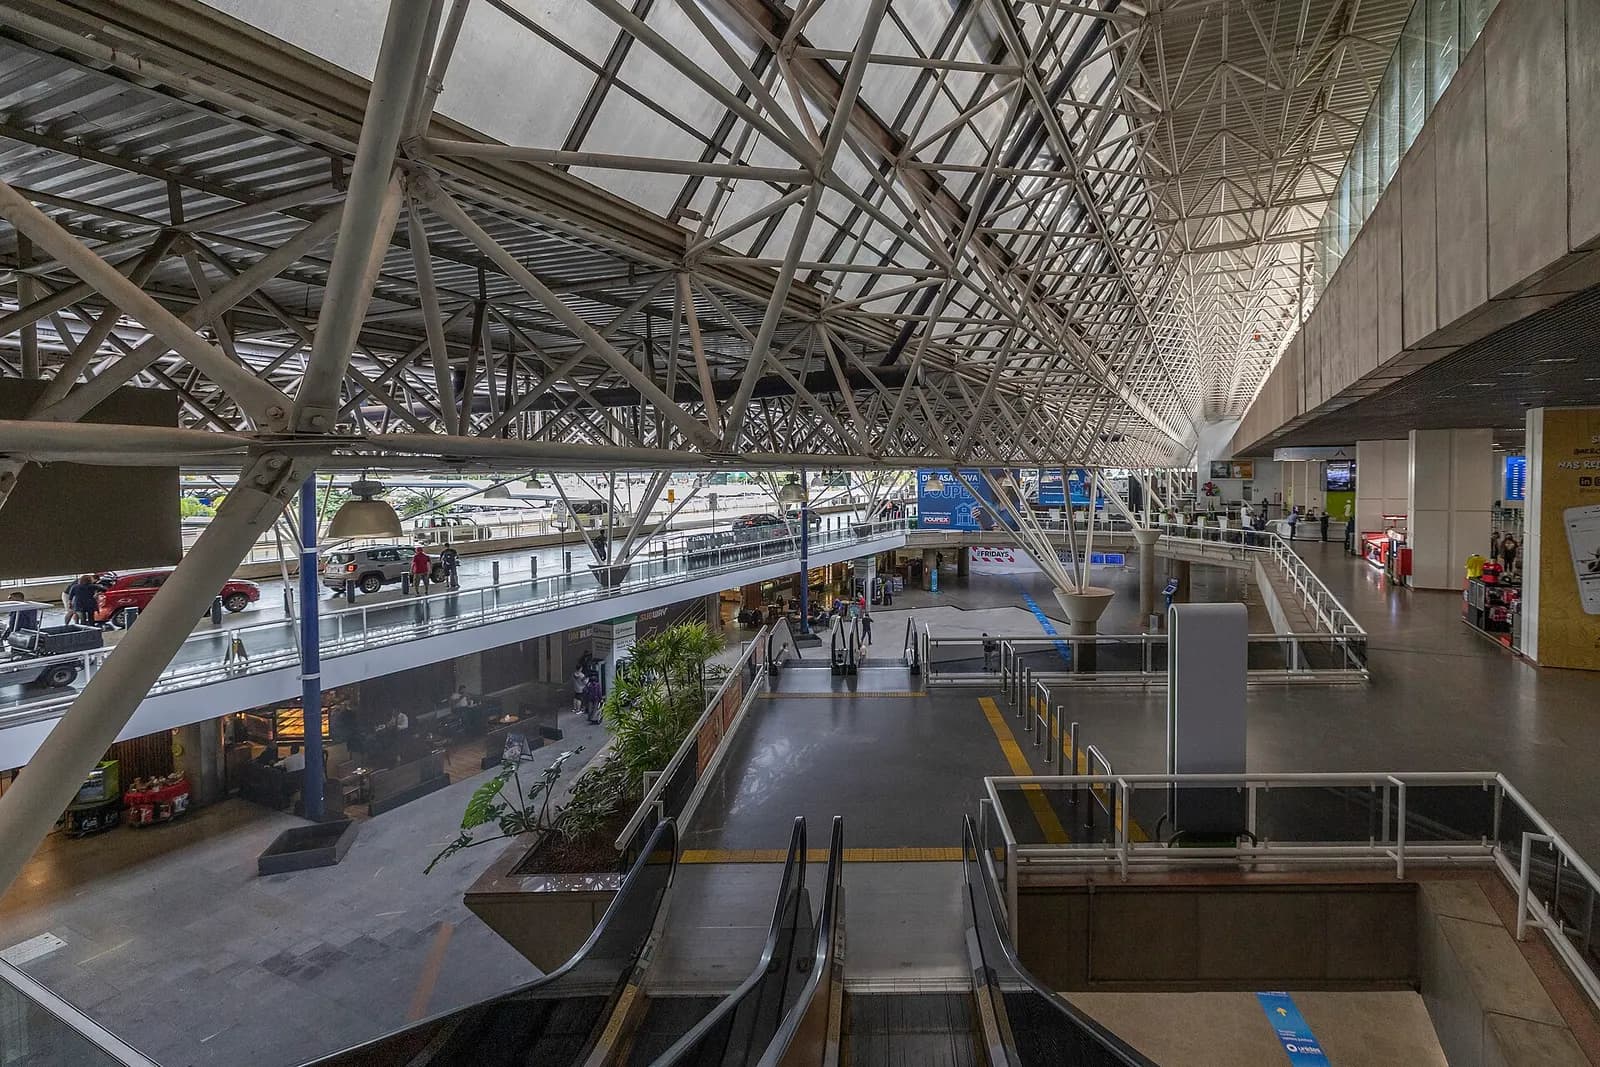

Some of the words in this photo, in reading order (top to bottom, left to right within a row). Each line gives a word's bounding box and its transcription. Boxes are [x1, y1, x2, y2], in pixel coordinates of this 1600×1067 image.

[935, 474, 954, 482] ASA
[955, 474, 978, 482] OVA
[981, 550, 1009, 558] FRIDAYS
[639, 608, 668, 621] SUBWAY
